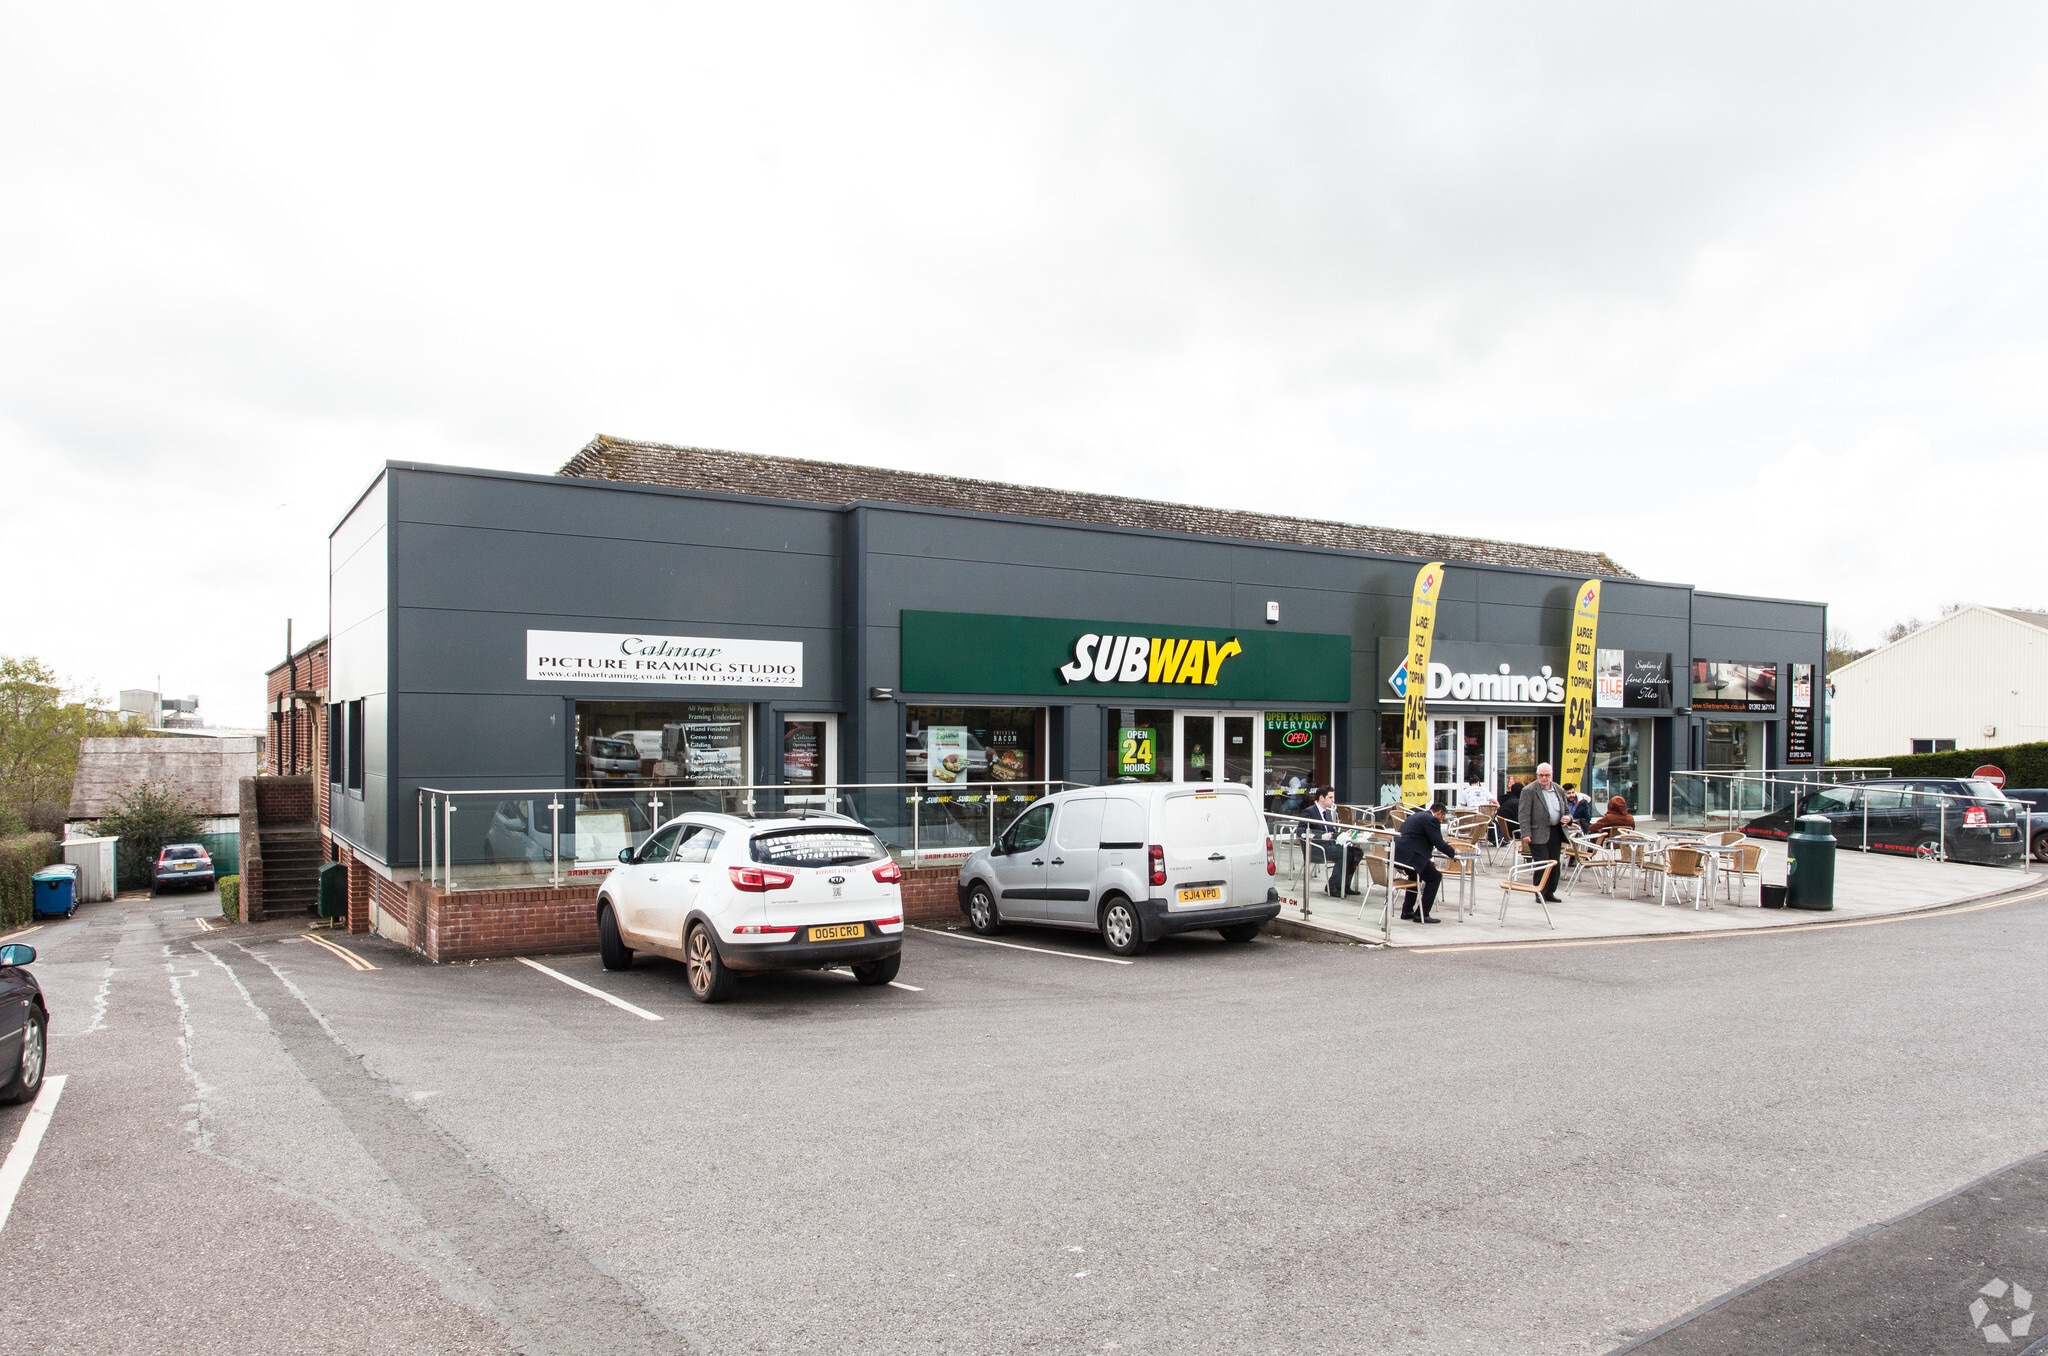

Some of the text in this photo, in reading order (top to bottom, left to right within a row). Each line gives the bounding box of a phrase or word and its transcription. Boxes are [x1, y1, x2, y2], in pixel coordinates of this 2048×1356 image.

[1576, 626, 1593, 640] LARGE
[620, 637, 723, 658] Calmar
[1576, 643, 1590, 656] PIZZA
[538, 657, 796, 674] PICTURE FRAMING STUDIO
[1060, 633, 1242, 686] SUBWAY
[1577, 660, 1588, 672] ONE
[538, 671, 667, 680] www.calmarframing.co.uk
[1624, 672, 1671, 686] fine Italian
[1424, 662, 1565, 703] Domino's
[1570, 676, 1592, 689] TOPPING
[1598, 678, 1622, 694] TILE
[1599, 692, 1622, 700] TRENDS
[1638, 686, 1658, 699] Tiles
[1794, 686, 1809, 696] TILE
[1266, 712, 1327, 721] OPEN 24 HOURS
[1268, 721, 1324, 729] EVERYDAY
[1127, 730, 1148, 739] OPEN
[1286, 732, 1309, 743] OPEN
[1122, 739, 1152, 764] 24
[1124, 764, 1150, 772] HOURS
[1184, 890, 1217, 900] SJ14 VPO
[840, 926, 859, 936] CRO
